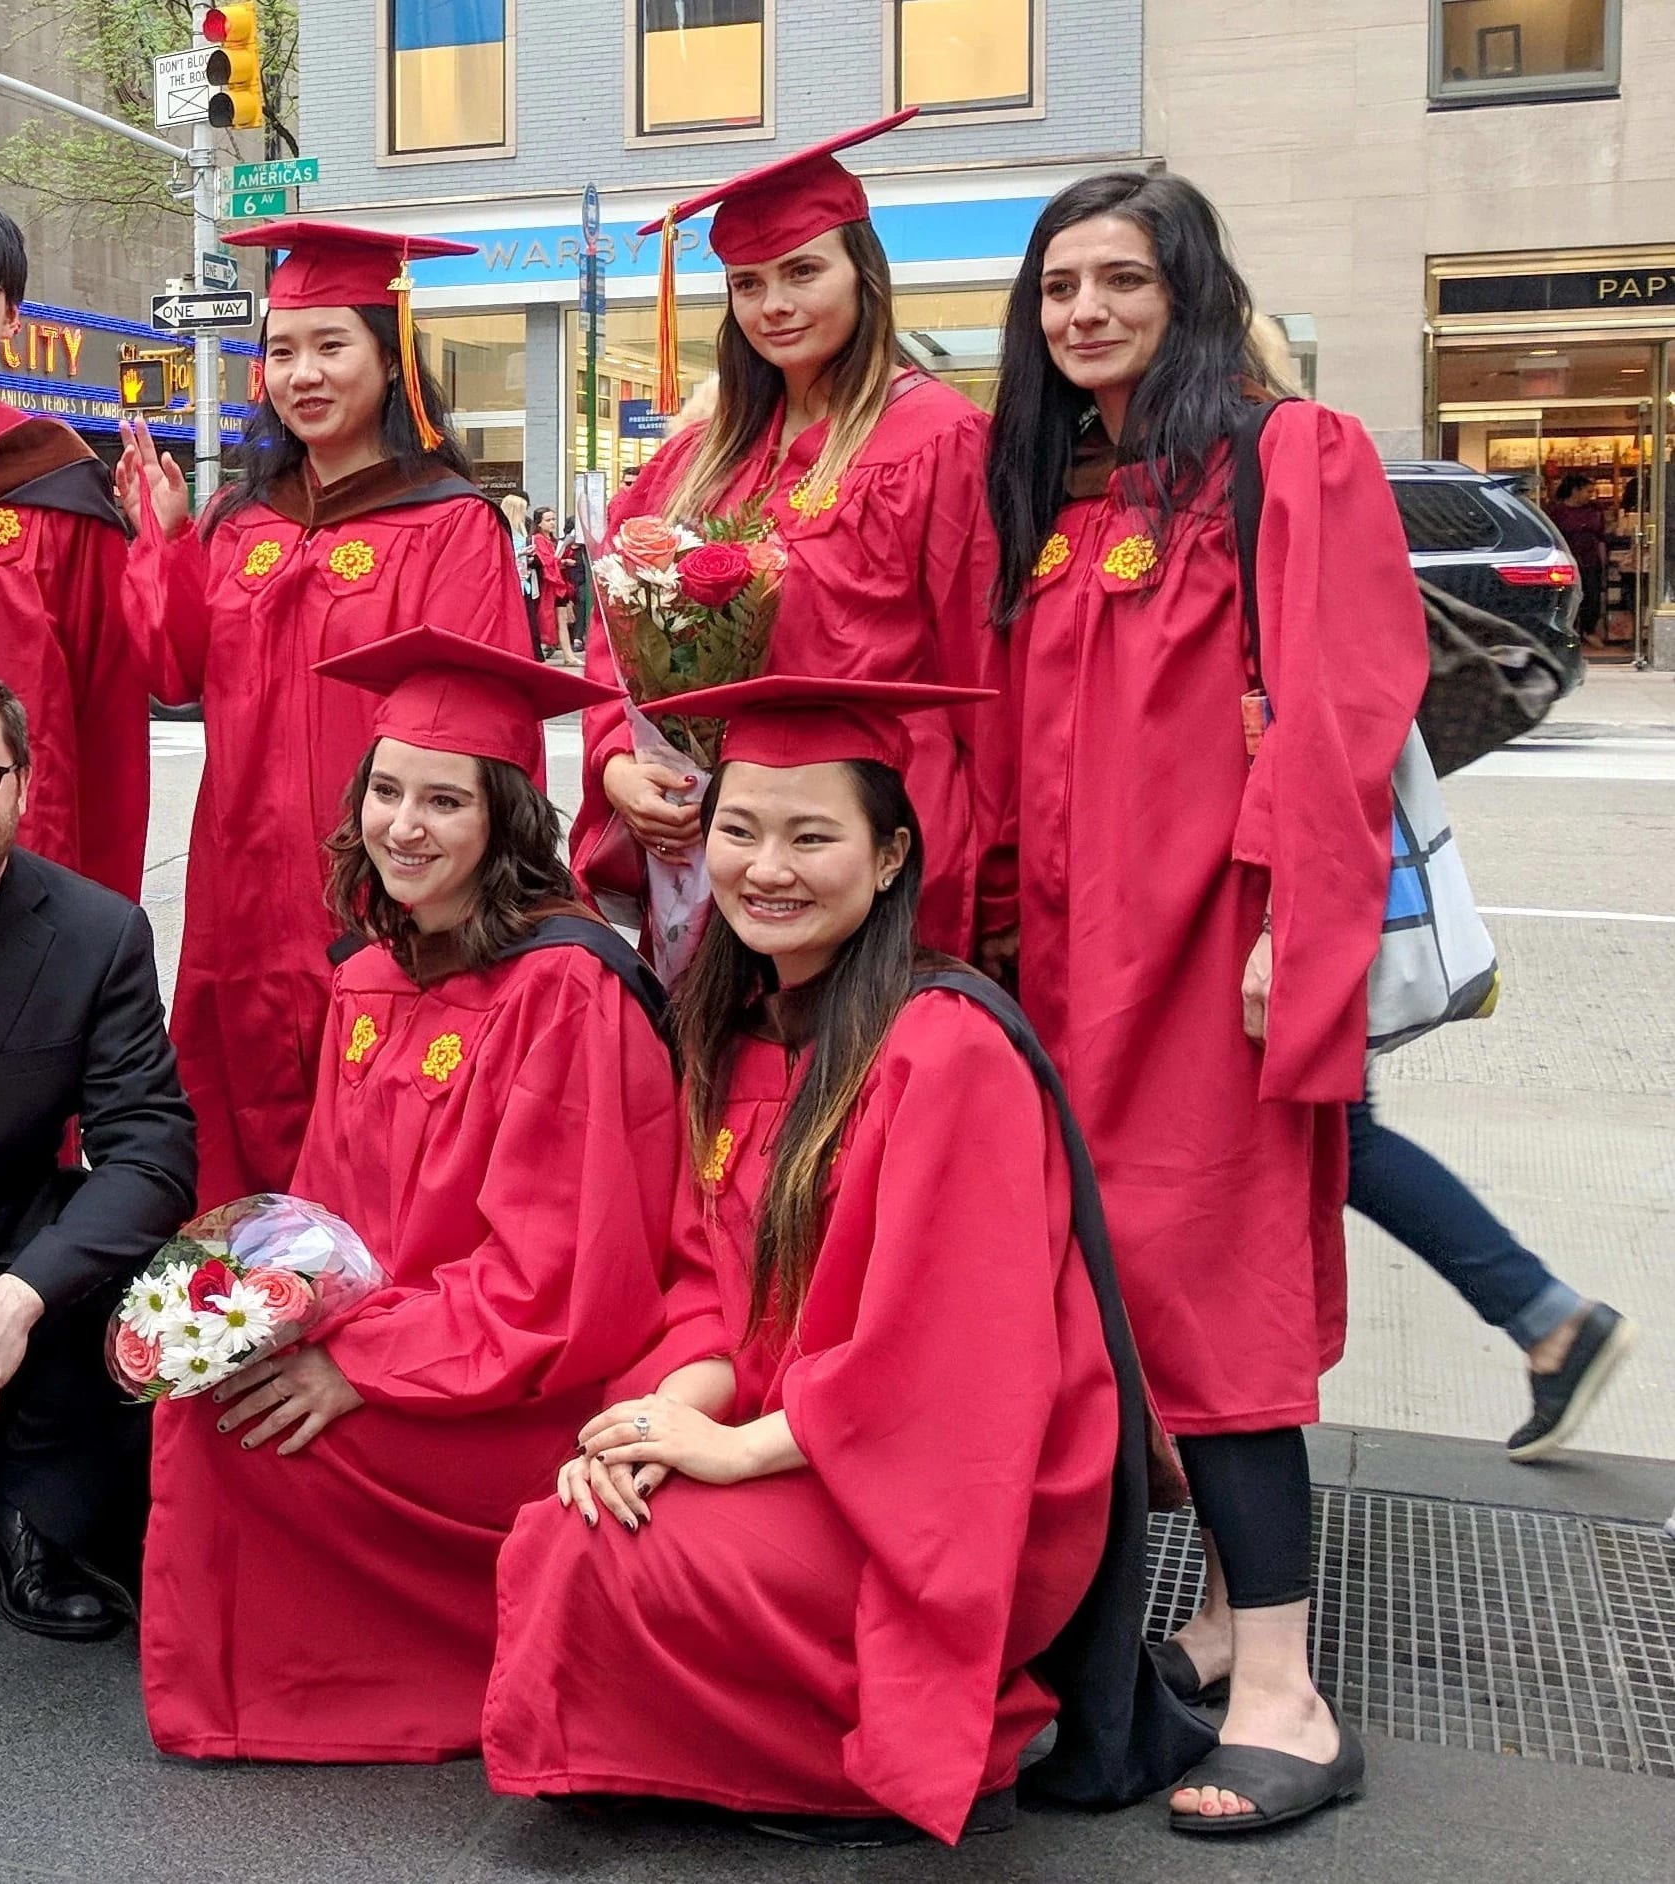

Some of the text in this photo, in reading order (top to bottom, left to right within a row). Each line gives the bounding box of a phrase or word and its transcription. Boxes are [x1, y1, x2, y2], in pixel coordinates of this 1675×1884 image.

[159, 53, 210, 75] DON'T BLOC
[169, 70, 207, 87] THE BOX
[253, 165, 267, 173] AVE
[283, 161, 297, 170] THE
[238, 168, 313, 187] AMERICAS
[243, 194, 275, 215] 6 AV
[482, 233, 646, 272] WARBY
[206, 264, 217, 277] ONE
[1599, 276, 1675, 299] PAP
[163, 302, 243, 319] ONE WAY
[42, 395, 77, 414] VERDES
[82, 400, 88, 415] Y
